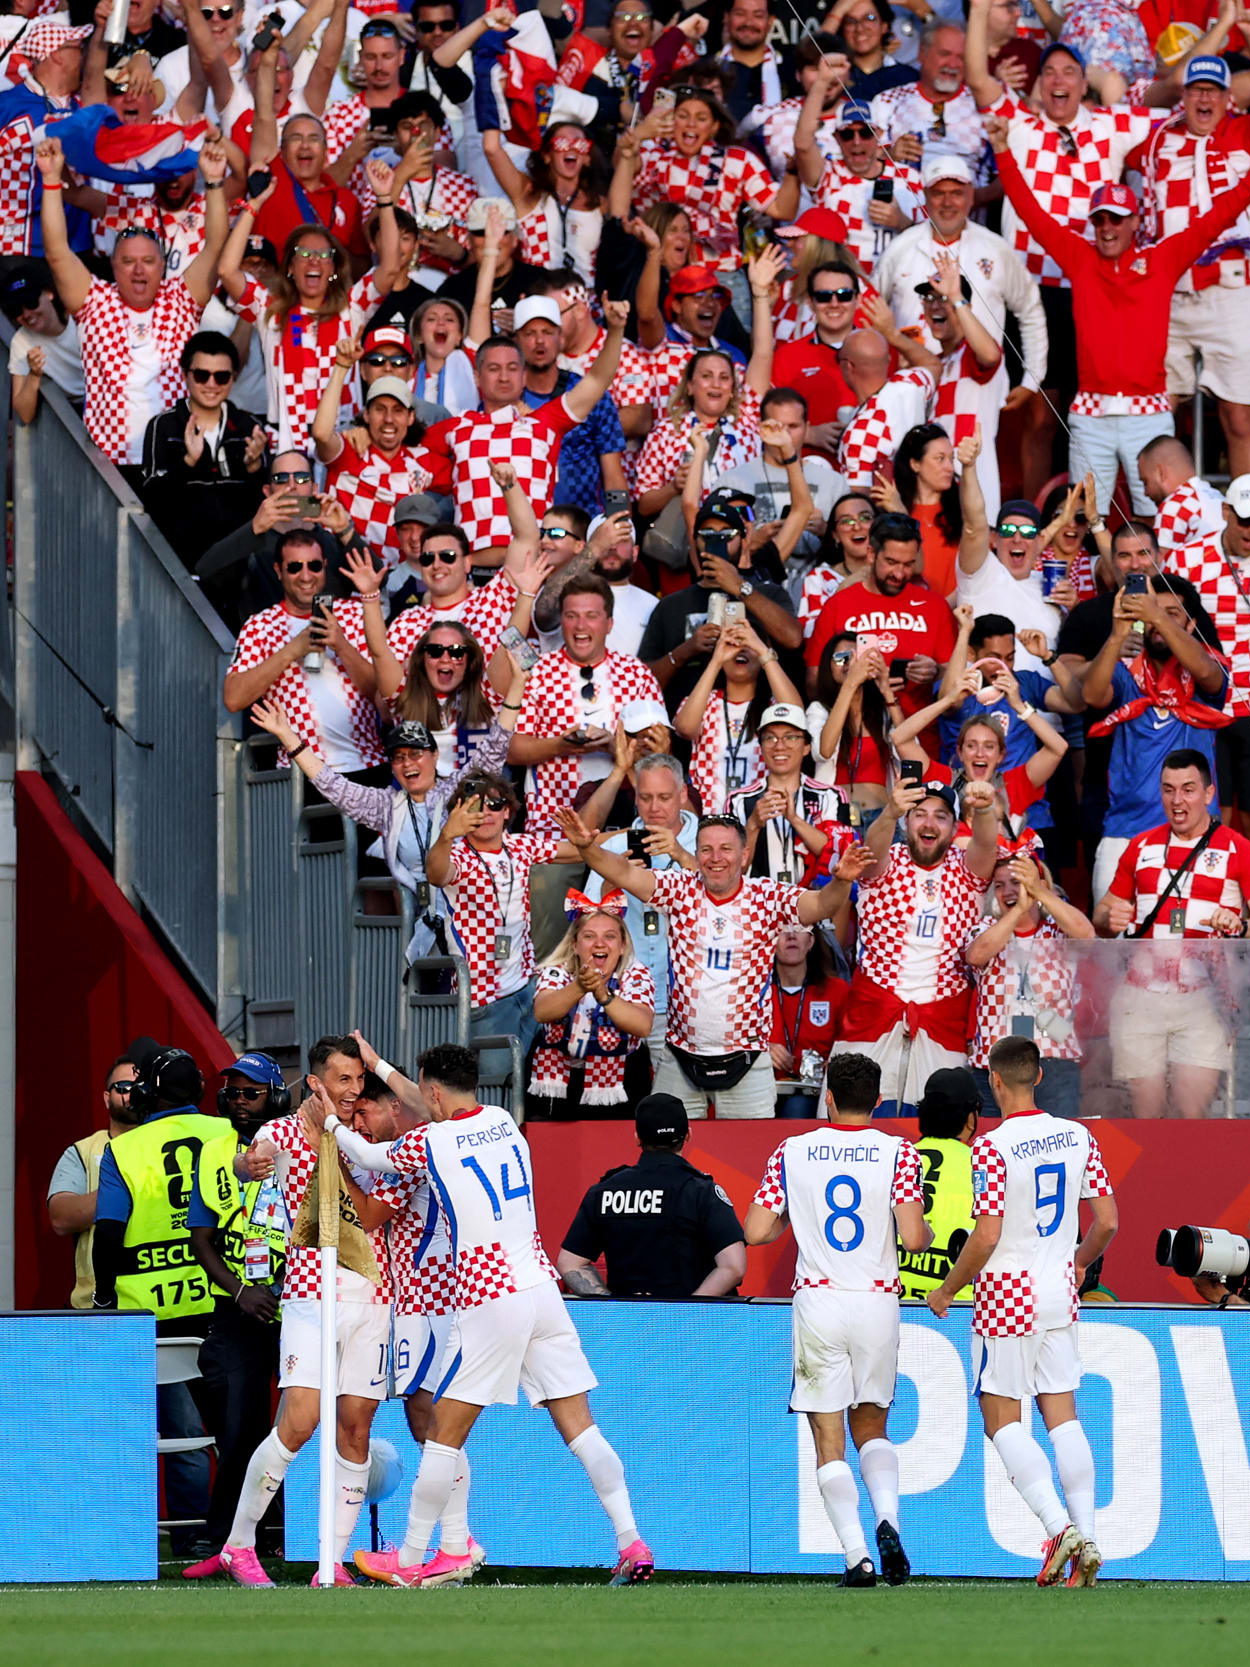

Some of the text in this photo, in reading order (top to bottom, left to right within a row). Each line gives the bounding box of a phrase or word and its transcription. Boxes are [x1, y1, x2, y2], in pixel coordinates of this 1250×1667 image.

[845, 611, 928, 633] CANADA
[917, 915, 938, 938] 10
[707, 946, 732, 971] 10
[456, 1120, 513, 1149] PERIŠIĆ
[808, 1144, 880, 1162] KOVAČIĆ
[460, 1144, 531, 1221] 14
[601, 1189, 664, 1215] POLICE
[824, 1174, 865, 1252] 8
[1035, 1163, 1067, 1239] 9
